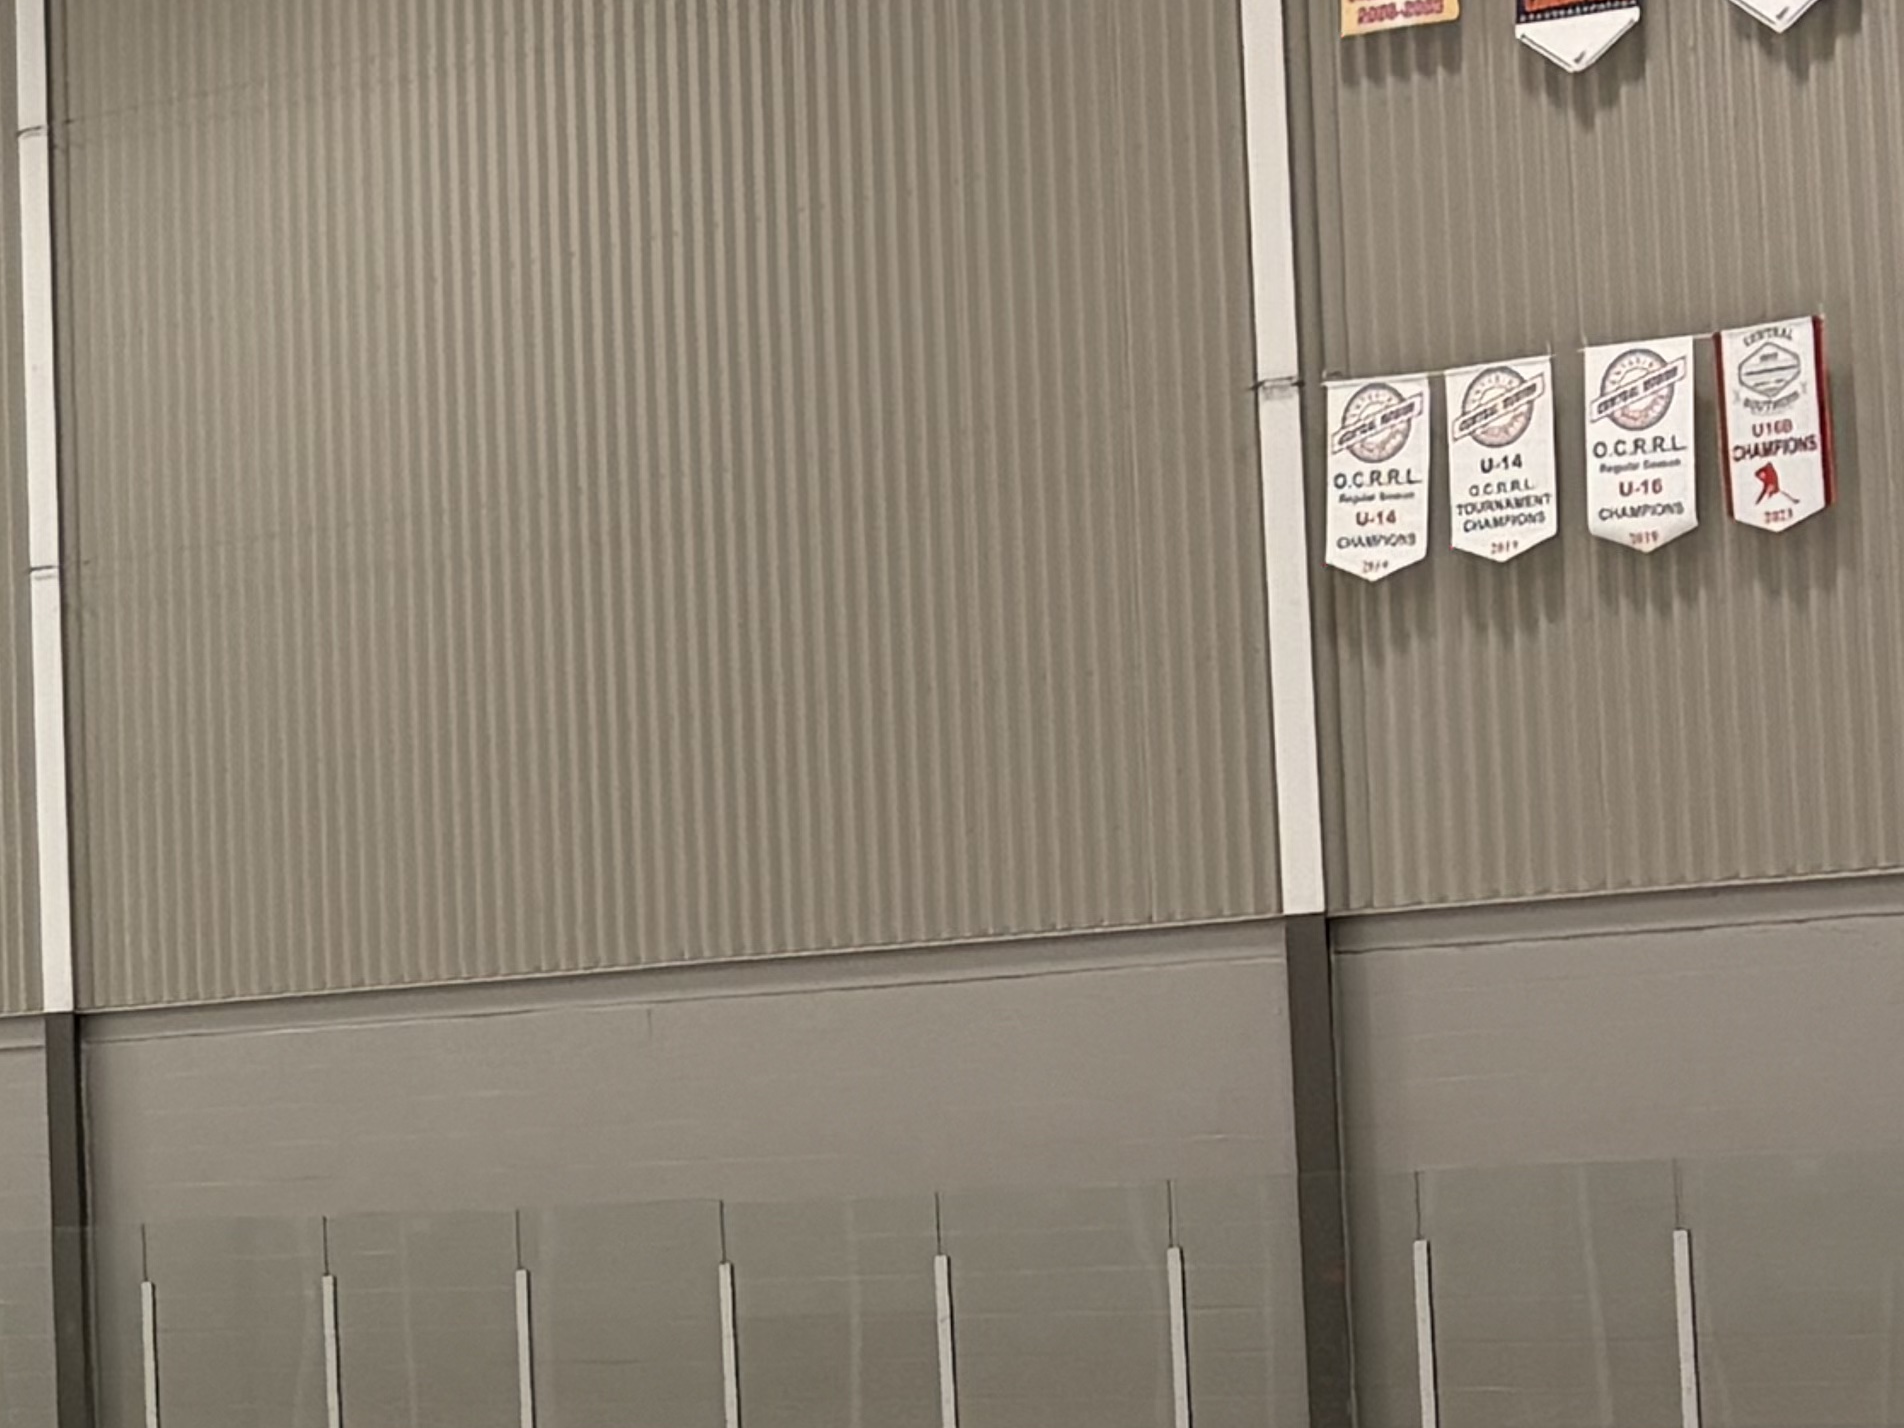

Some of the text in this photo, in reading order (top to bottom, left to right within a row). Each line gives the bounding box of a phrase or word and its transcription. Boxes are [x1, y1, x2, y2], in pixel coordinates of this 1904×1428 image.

[1732, 435, 1817, 461] CHAMPIONS
[1480, 453, 1522, 473] U-14
[1456, 493, 1552, 516] TOURNAMENT
[1598, 502, 1684, 521] CHAMPIONS
[1463, 511, 1545, 533] CHAMPIONS
